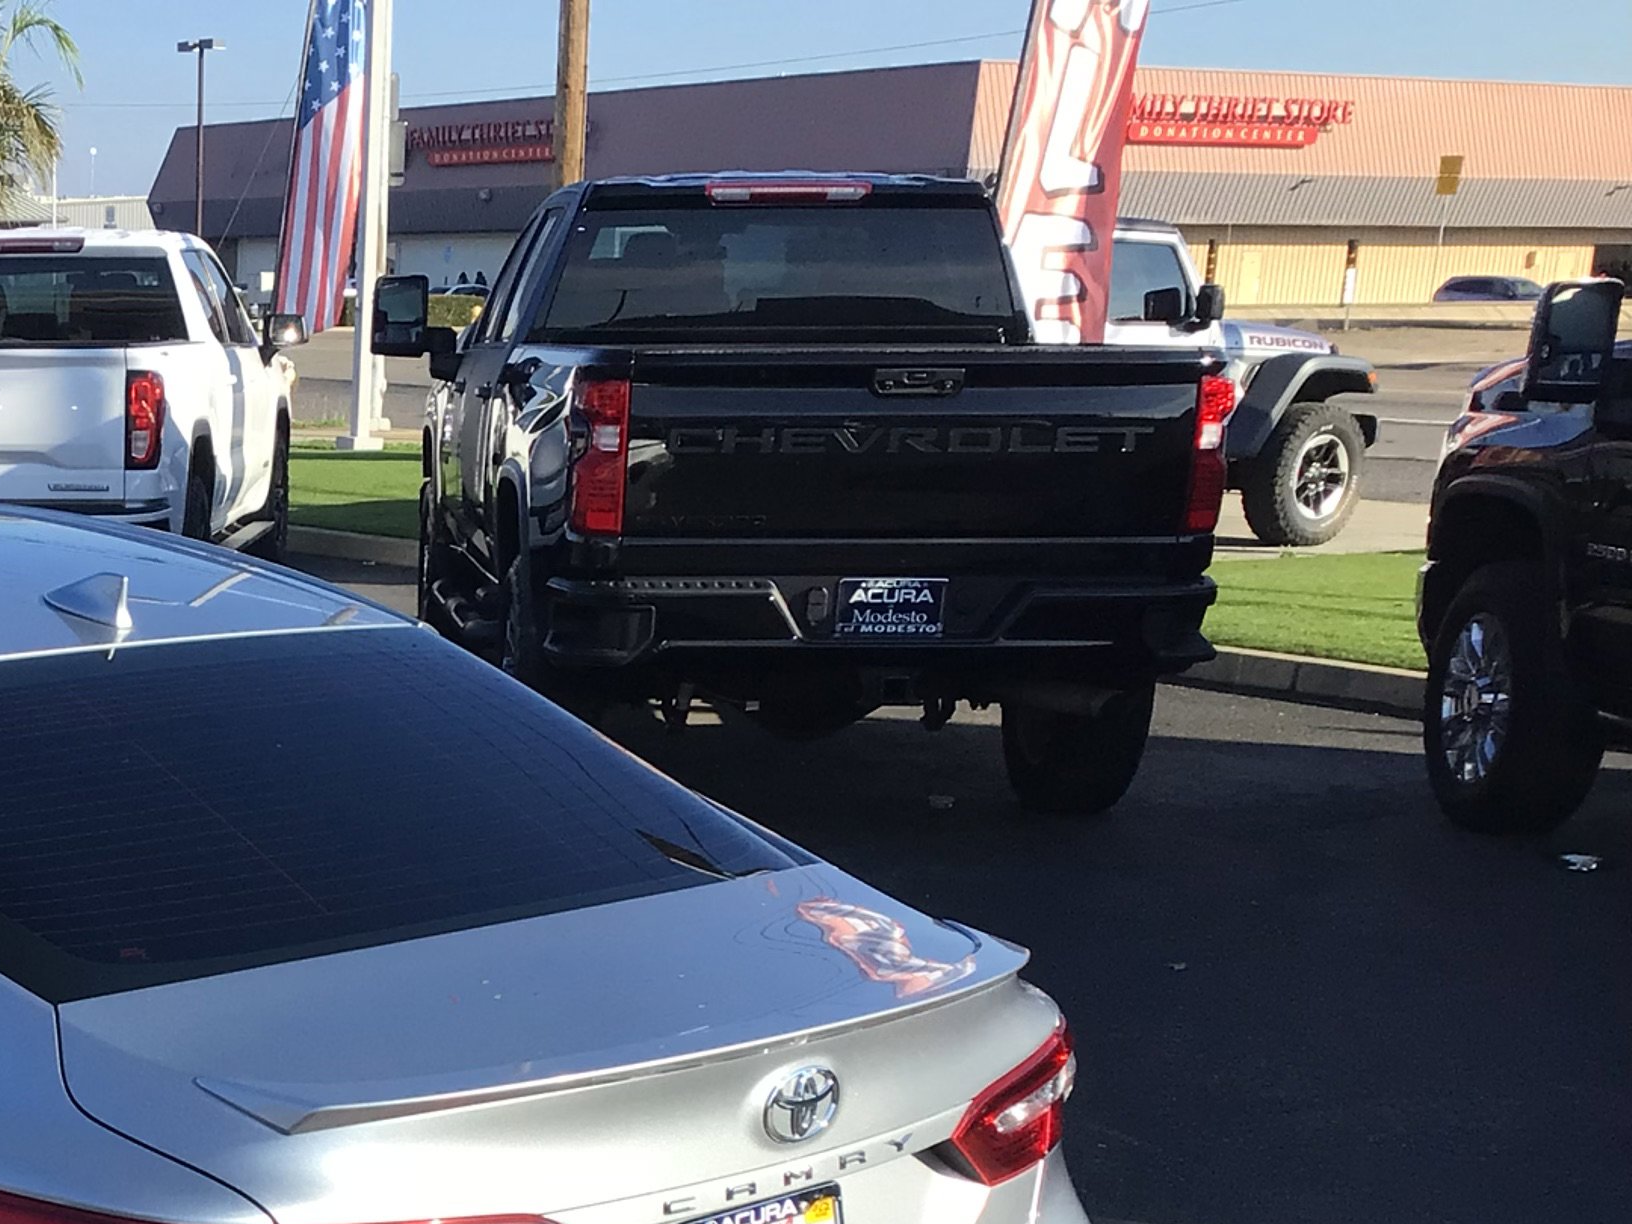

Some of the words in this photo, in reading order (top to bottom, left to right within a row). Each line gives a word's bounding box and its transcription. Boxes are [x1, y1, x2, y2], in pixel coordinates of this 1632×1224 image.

[1192, 94, 1279, 124] THRIFT
[1283, 98, 1356, 126] STORE
[1140, 125, 1234, 139] DONATION
[1240, 125, 1306, 142] CENTER
[1249, 335, 1325, 350] RUBICON
[670, 426, 1155, 454] CHEVROLET
[849, 588, 934, 603] ACURA
[852, 608, 928, 623] Modesto
[859, 623, 937, 633] MODESTO
[663, 1133, 913, 1215] CAMRY
